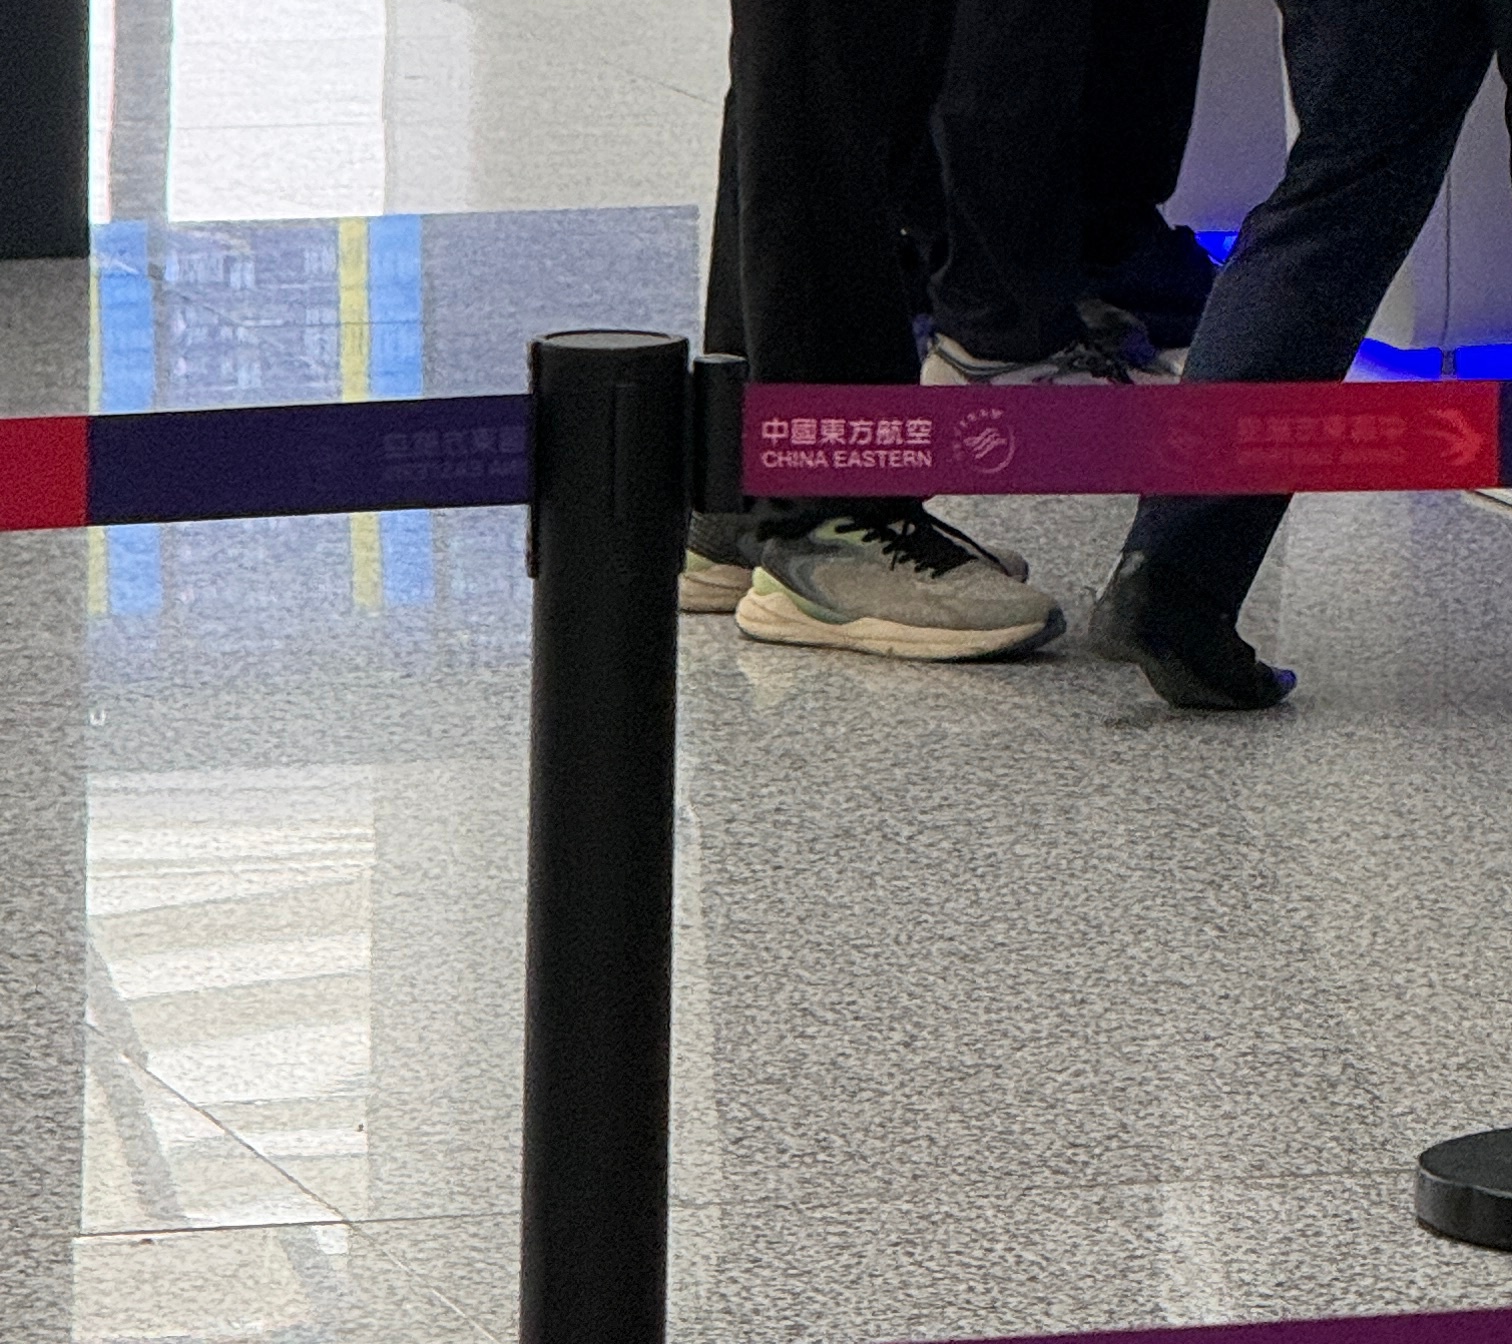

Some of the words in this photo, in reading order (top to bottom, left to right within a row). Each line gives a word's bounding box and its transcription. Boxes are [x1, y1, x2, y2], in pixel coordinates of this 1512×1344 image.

[760, 417, 933, 446] 中國東方航空
[761, 450, 828, 469] CHINA
[834, 449, 933, 468] EASTERN
